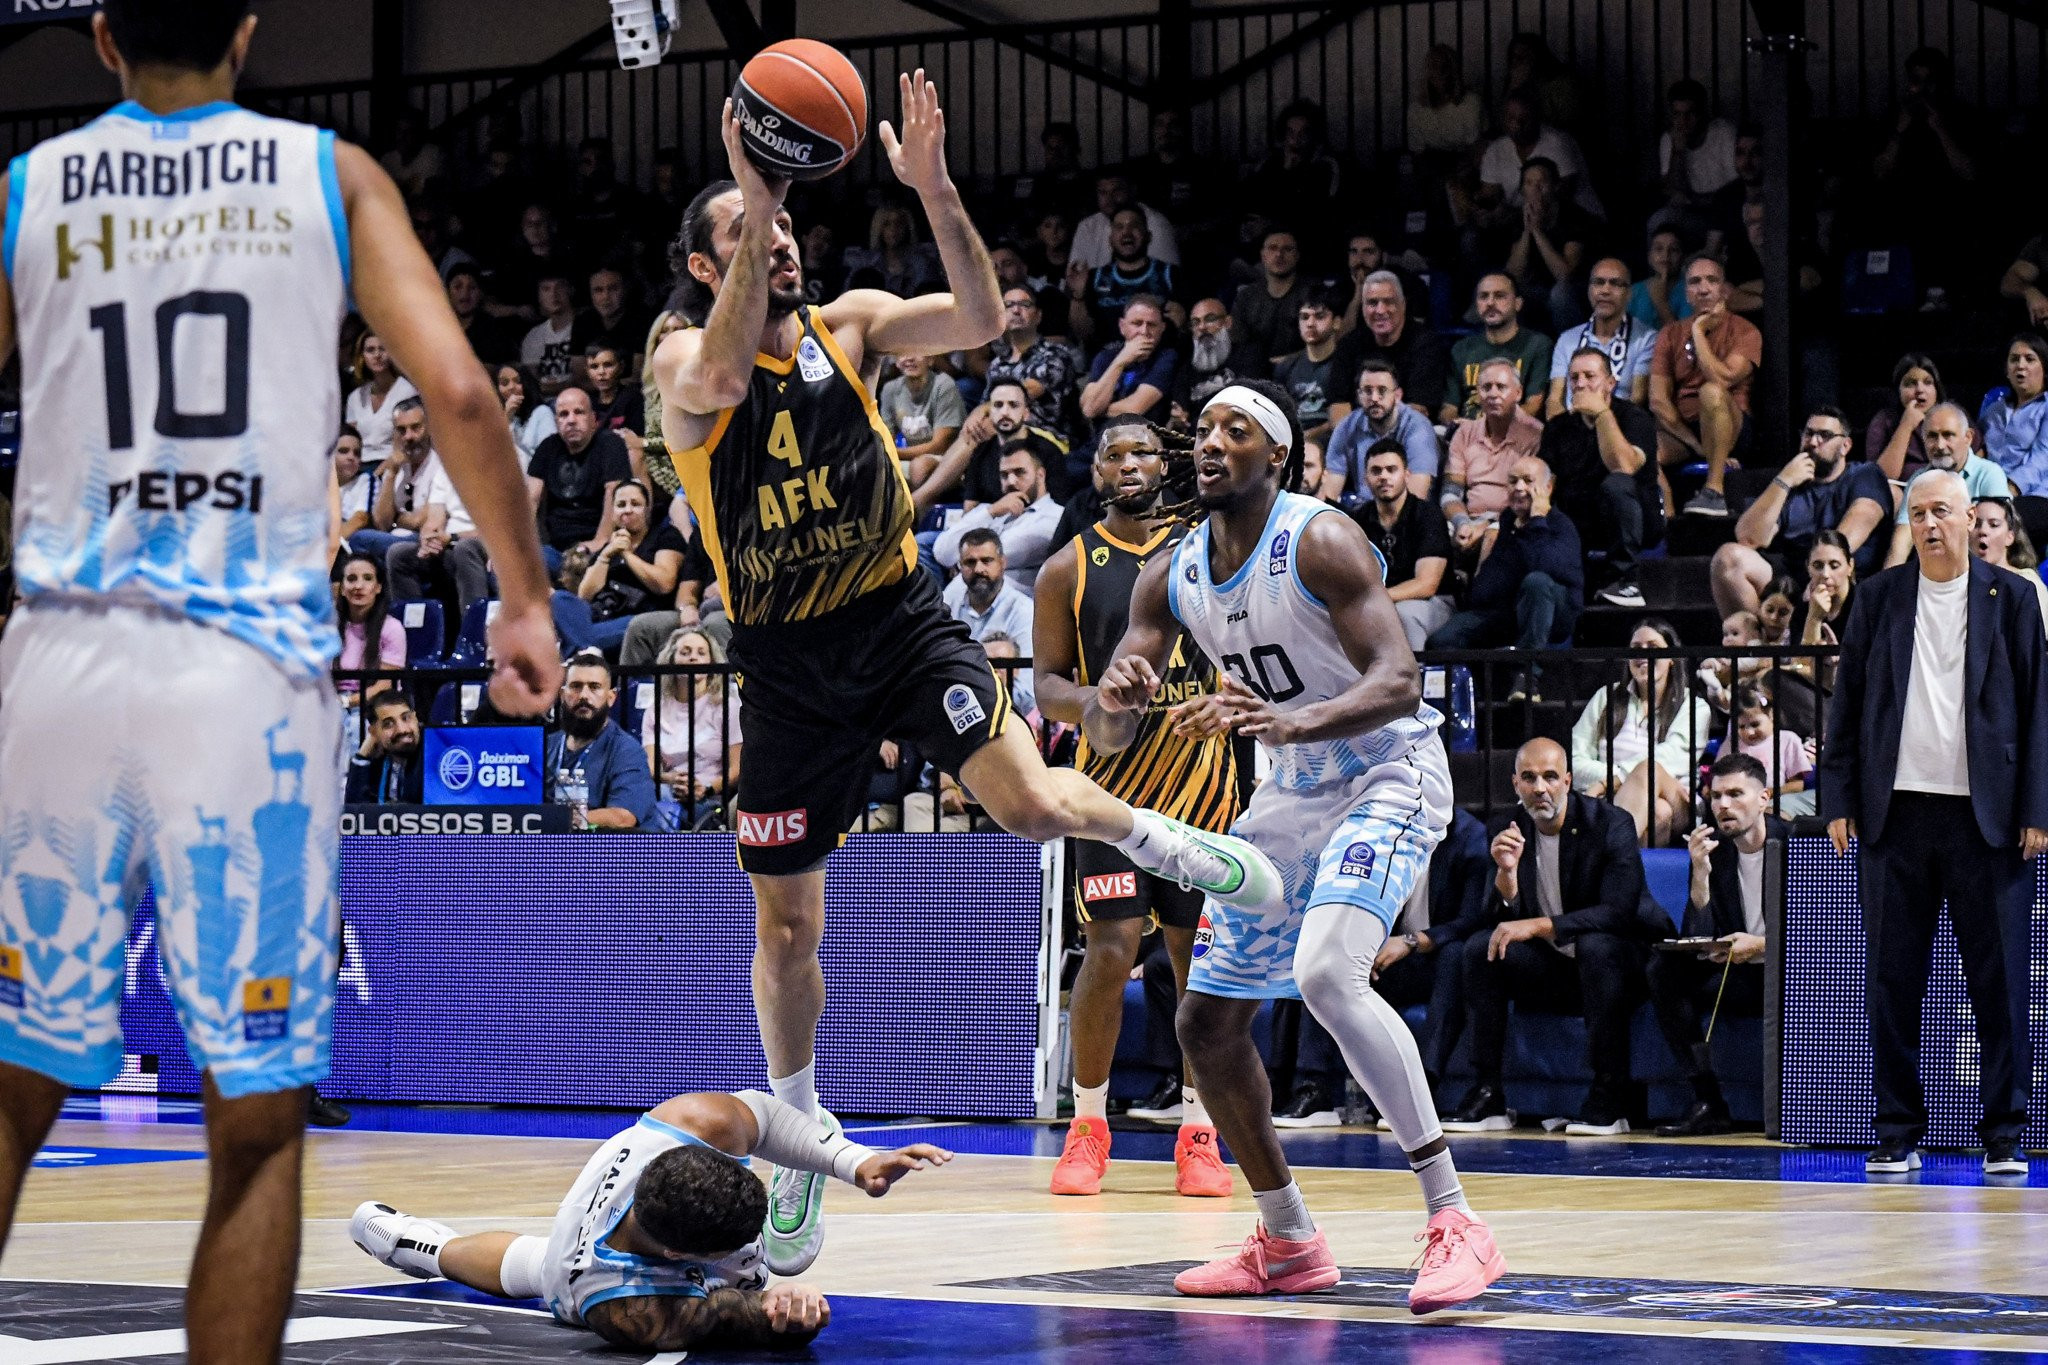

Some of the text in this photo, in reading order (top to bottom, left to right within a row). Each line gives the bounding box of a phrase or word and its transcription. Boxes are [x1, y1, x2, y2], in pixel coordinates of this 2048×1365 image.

[734, 98, 813, 163] SPALDING
[62, 139, 278, 204] BARBITCH
[130, 205, 294, 241] HOTELS
[89, 289, 250, 450] 10
[804, 369, 830, 379] GBL
[767, 409, 803, 468] 4
[1227, 609, 1249, 624] FILA
[1220, 643, 1306, 704] 30
[957, 711, 982, 730] GBL
[478, 765, 525, 787] GBL
[339, 813, 543, 836] OLOSSOS B.C
[738, 812, 805, 843] AVIS
[1341, 865, 1369, 878] GBL
[1085, 874, 1135, 899] AVIS
